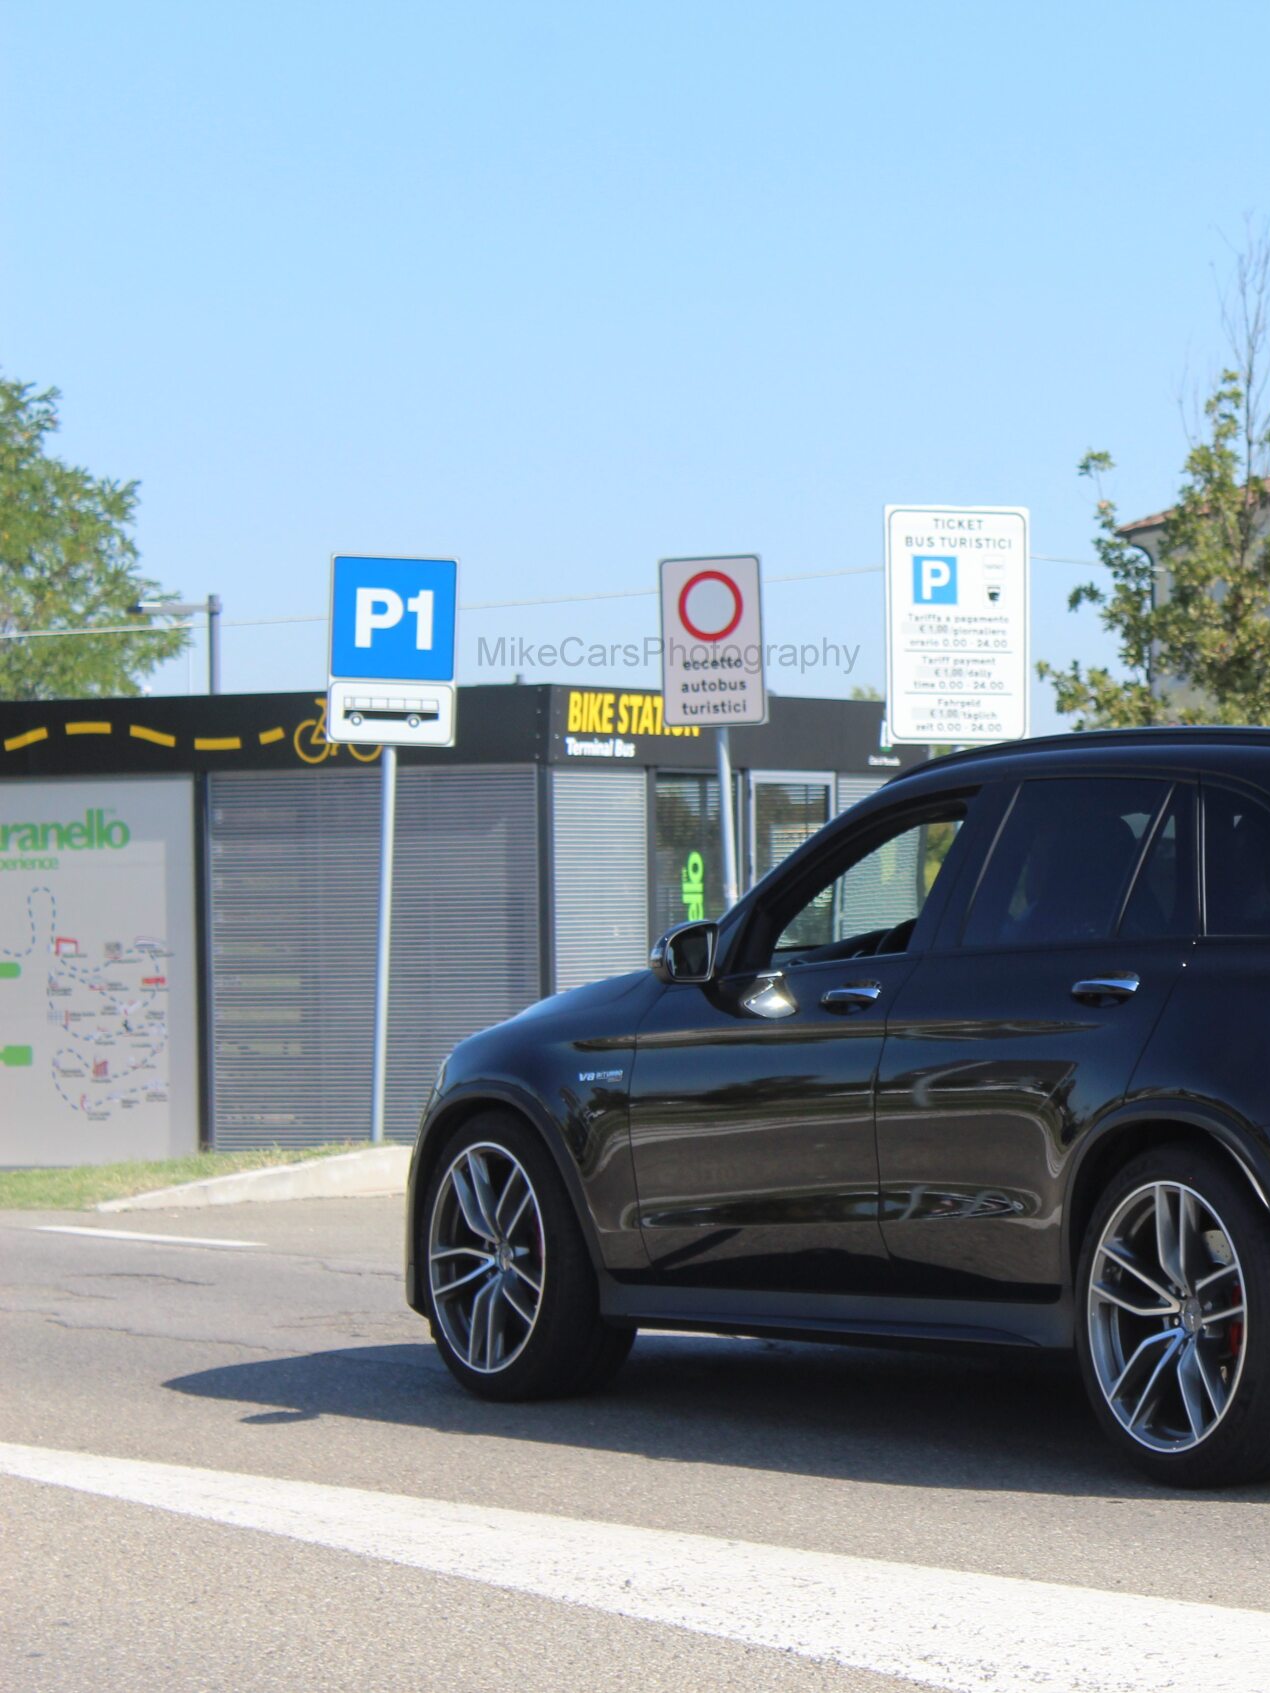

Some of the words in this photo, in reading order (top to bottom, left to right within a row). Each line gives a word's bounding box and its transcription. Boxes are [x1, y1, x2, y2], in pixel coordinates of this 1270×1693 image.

[933, 518, 984, 531] TICKET
[905, 536, 935, 548] BUS
[939, 536, 1012, 550] TURISTICI
[921, 559, 951, 600] P
[354, 586, 434, 651] P1
[682, 656, 743, 671] eccetto
[921, 656, 950, 665] Tariff
[953, 657, 996, 666] payment
[681, 679, 748, 693] autobus
[914, 680, 935, 689] time
[568, 691, 616, 734] BIKE
[617, 694, 700, 737] STAT
[682, 700, 747, 715] turistici
[566, 737, 613, 757] Terminal
[614, 738, 636, 758] Bus
[0, 808, 130, 851] ranello
